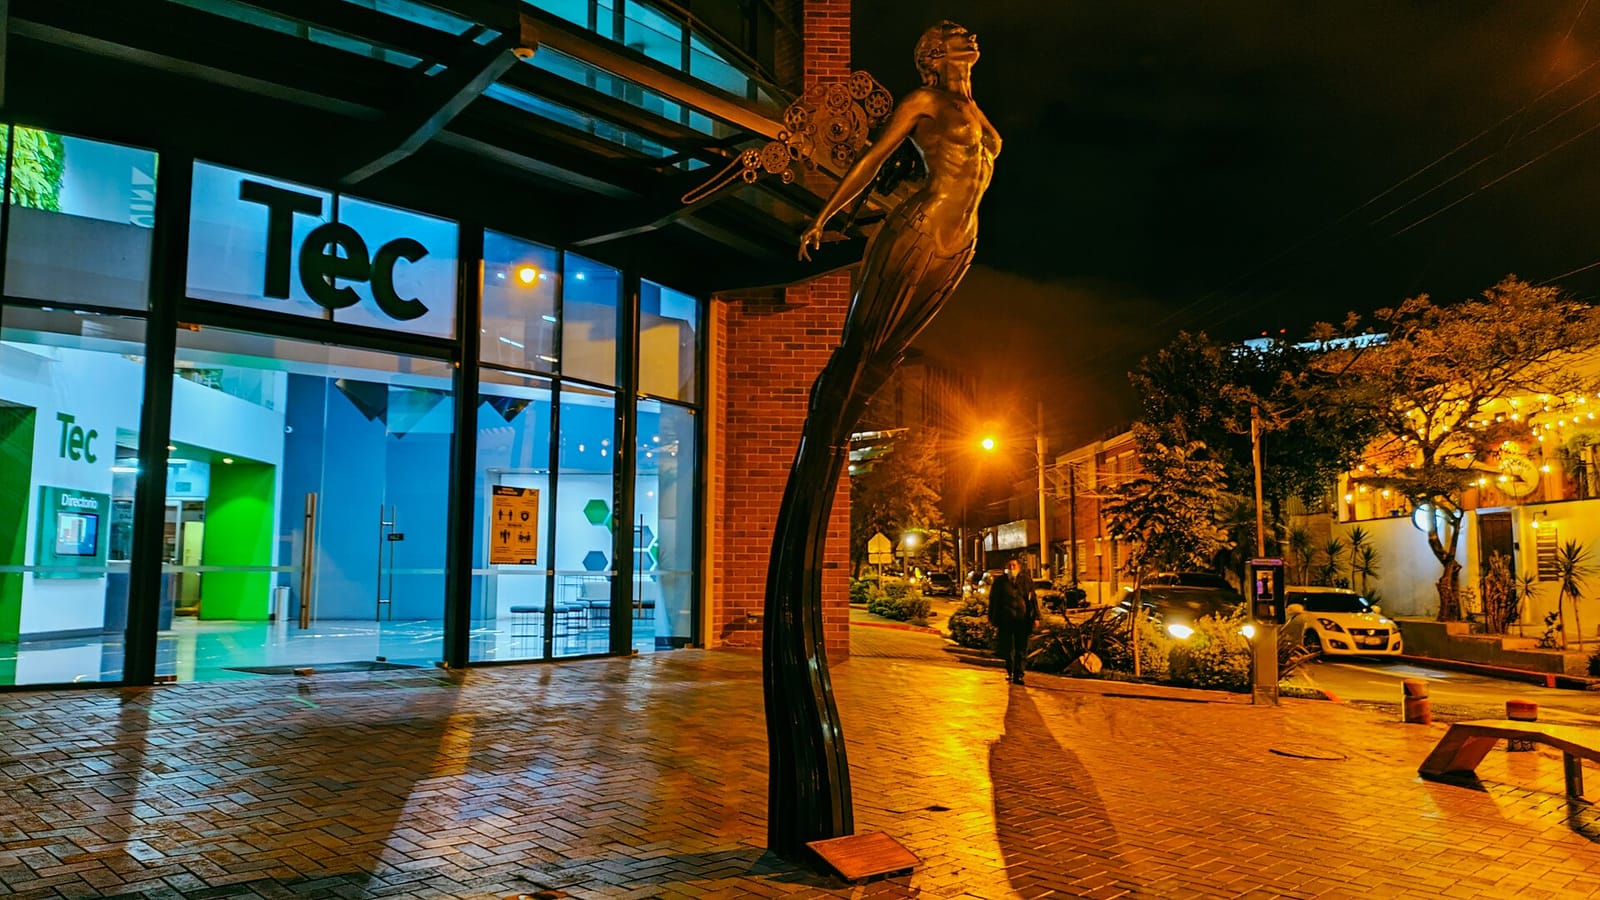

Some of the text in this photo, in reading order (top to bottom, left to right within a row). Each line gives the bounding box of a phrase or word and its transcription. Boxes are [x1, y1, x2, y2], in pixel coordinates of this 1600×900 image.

[239, 179, 429, 321] Tec
[56, 411, 98, 464] Tec
[61, 493, 97, 509] Directorio
